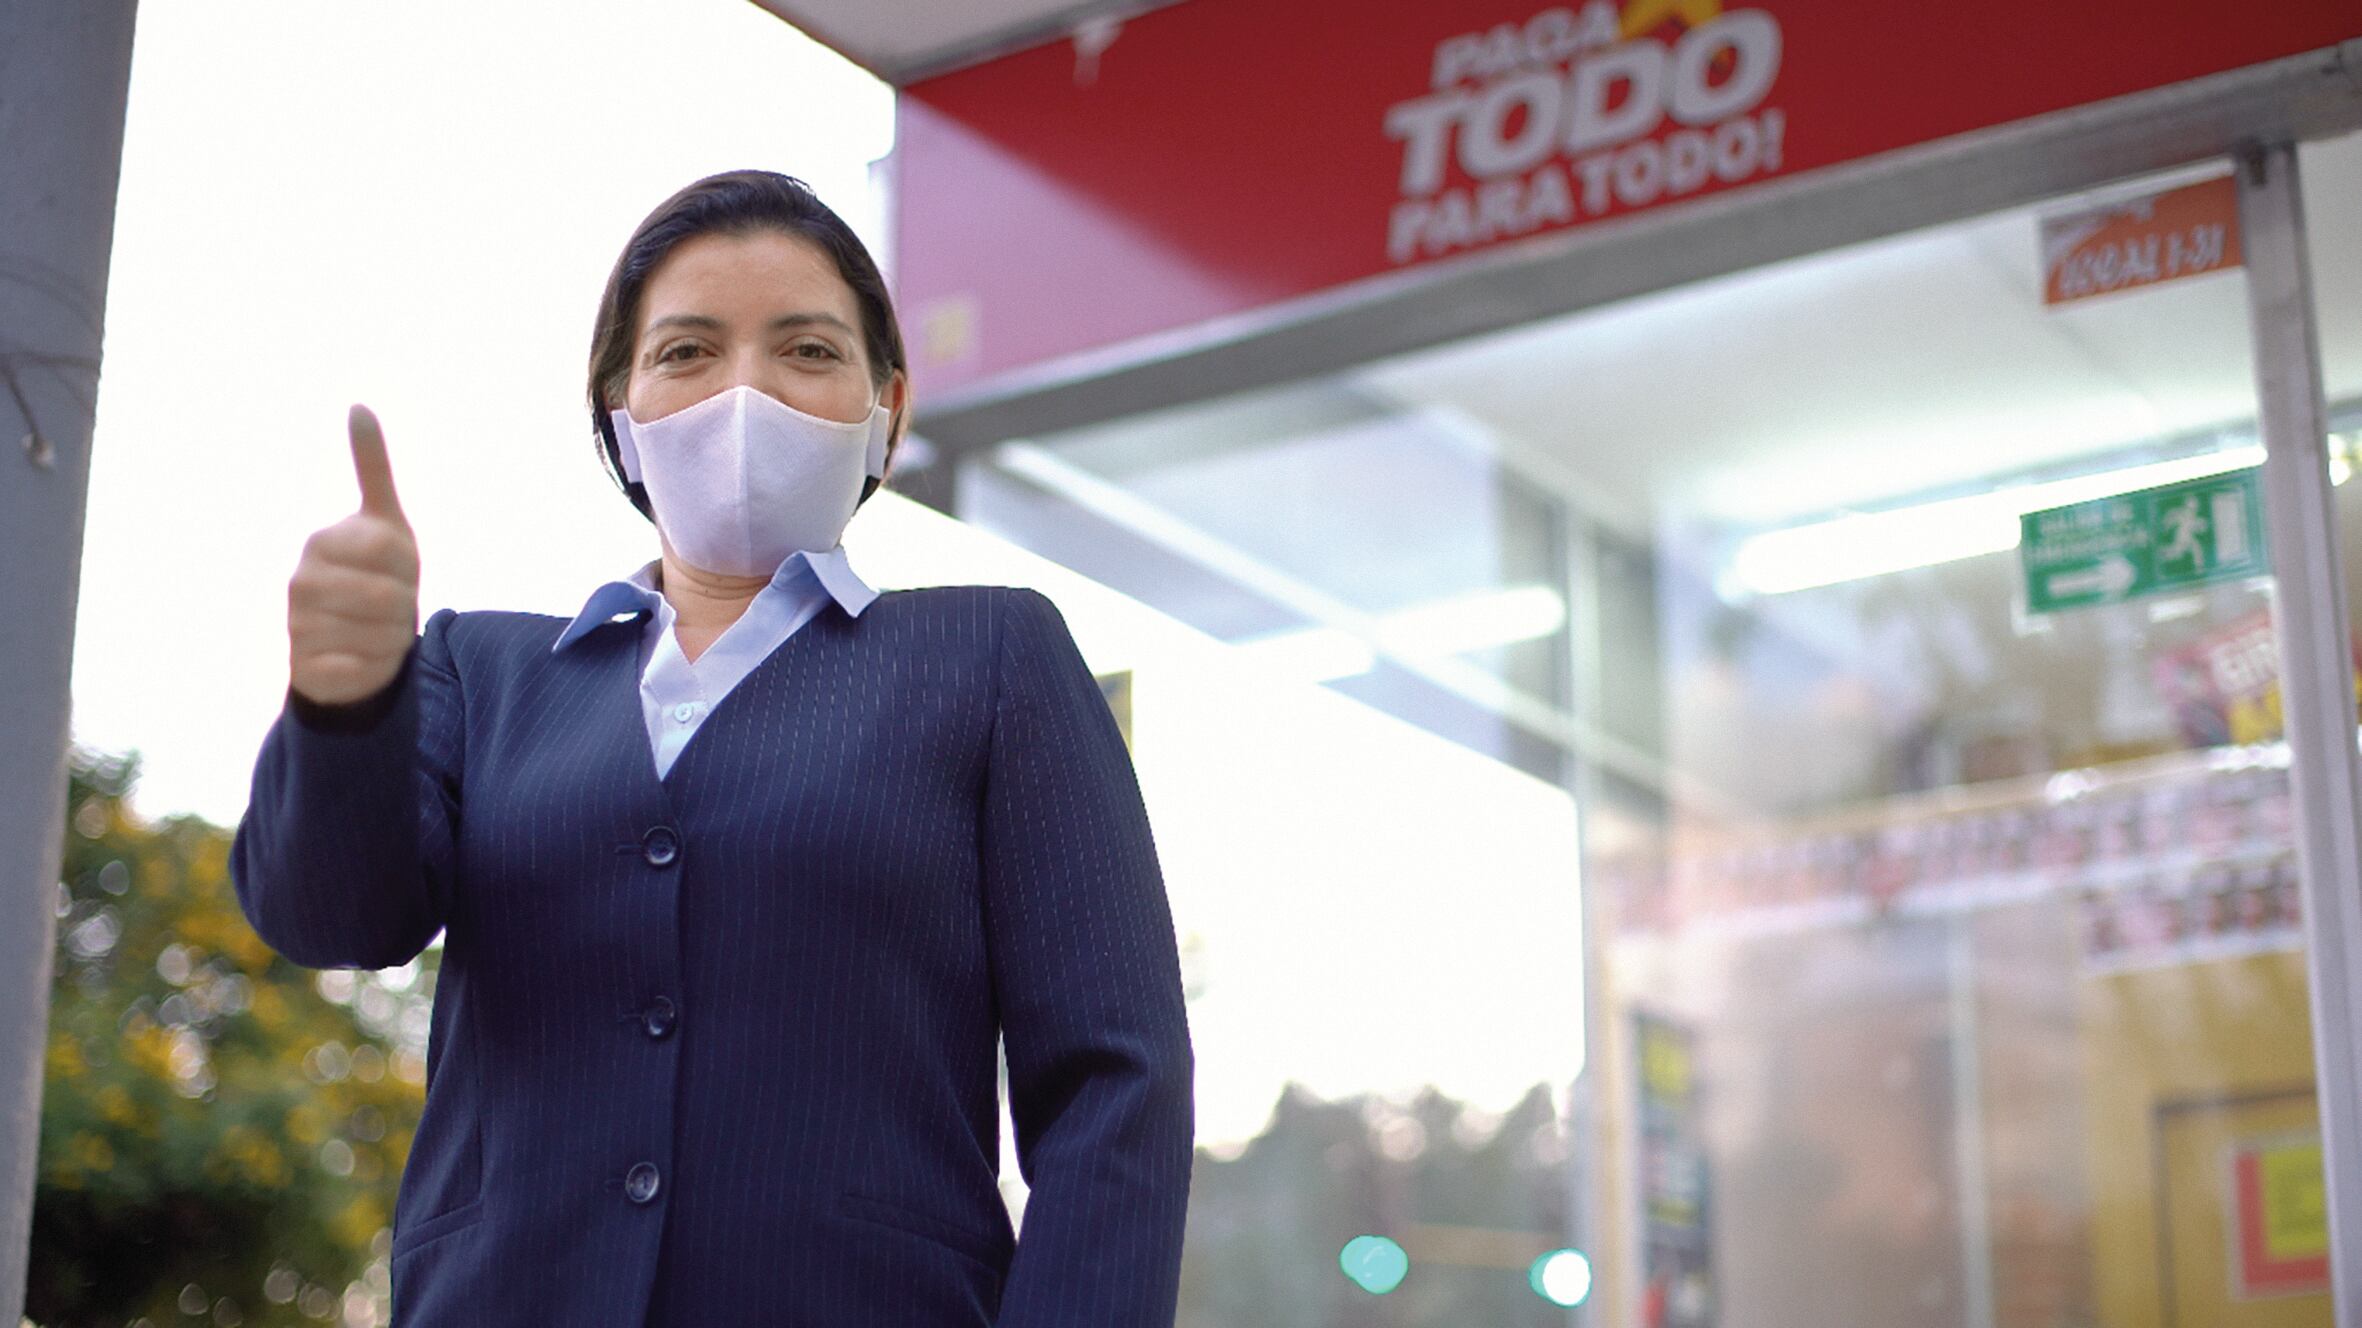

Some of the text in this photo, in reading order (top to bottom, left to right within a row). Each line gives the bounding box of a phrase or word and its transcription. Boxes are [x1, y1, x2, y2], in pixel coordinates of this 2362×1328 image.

[1383, 8, 1783, 198] TODO
[1386, 106, 1787, 264] PARA TODO!
